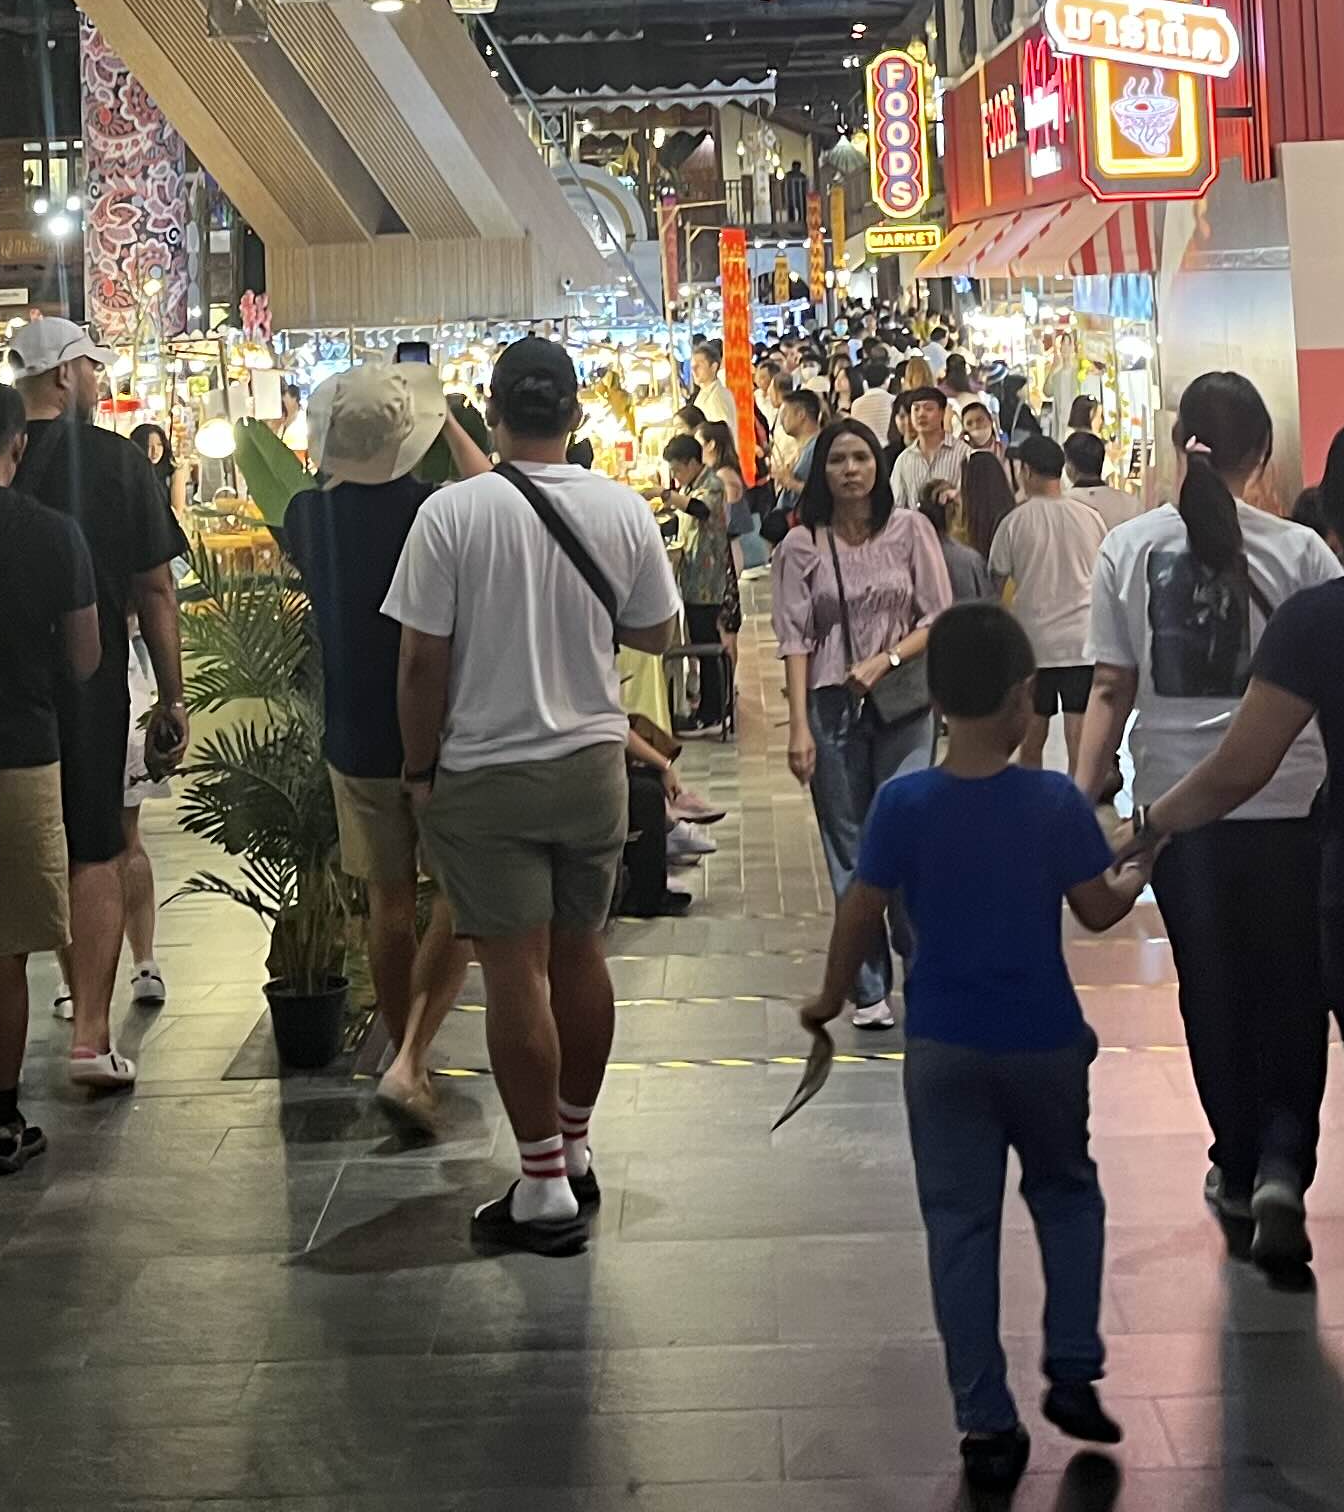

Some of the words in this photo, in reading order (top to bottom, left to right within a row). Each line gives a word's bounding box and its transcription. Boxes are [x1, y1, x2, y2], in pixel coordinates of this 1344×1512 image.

[1063, 4, 1224, 64] มาร์เก็ต
[884, 61, 913, 207] FOODS
[870, 231, 936, 247] MARKET
